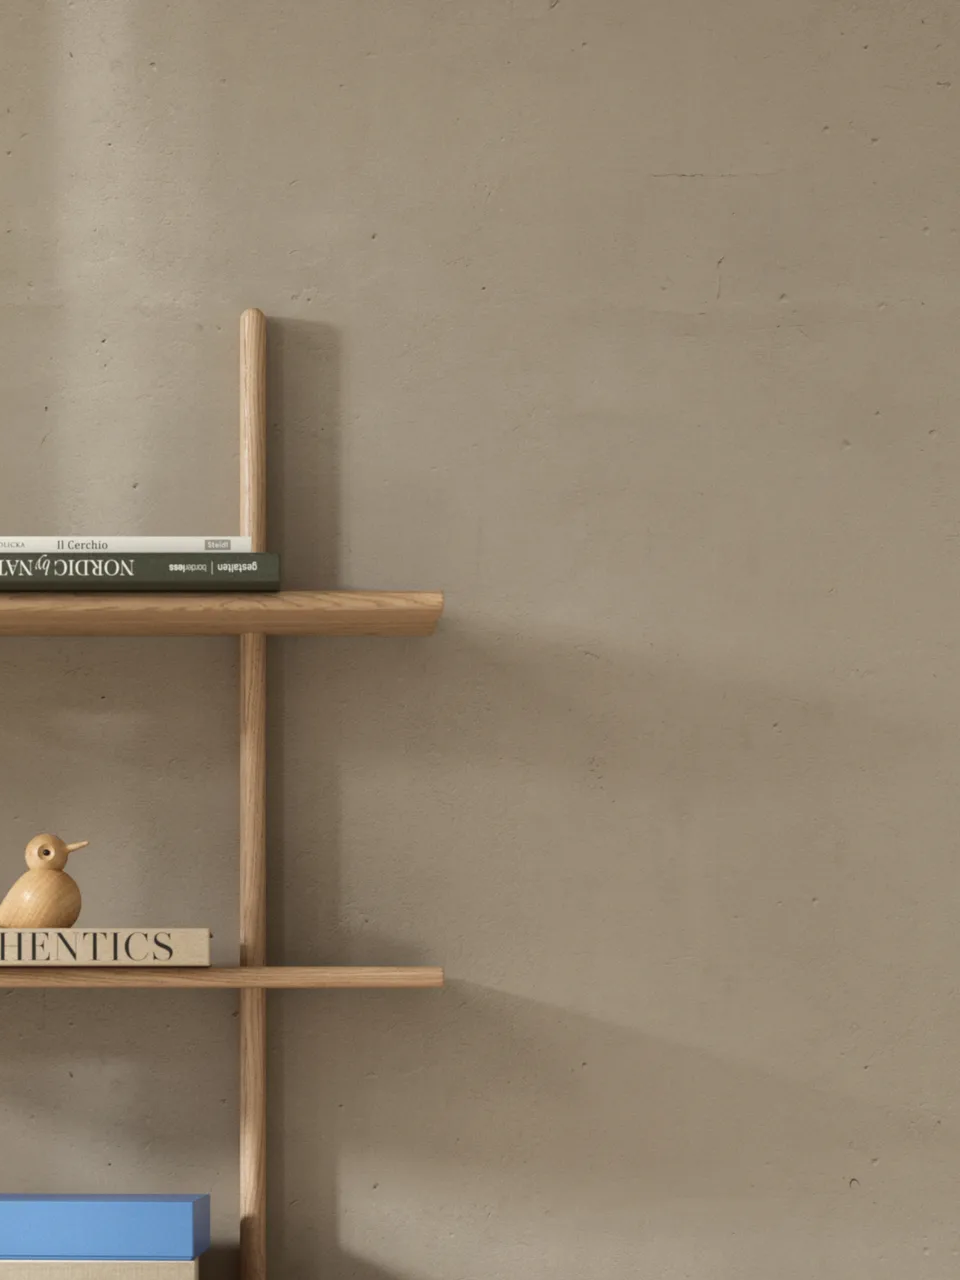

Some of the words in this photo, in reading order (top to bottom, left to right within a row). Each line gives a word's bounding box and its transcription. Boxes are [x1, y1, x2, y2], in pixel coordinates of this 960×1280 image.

[67, 540, 108, 550] Cerchio
[34, 554, 51, 576] by
[53, 559, 135, 576] NORDIC
[169, 563, 208, 573] borderless
[217, 561, 258, 573] gestalten
